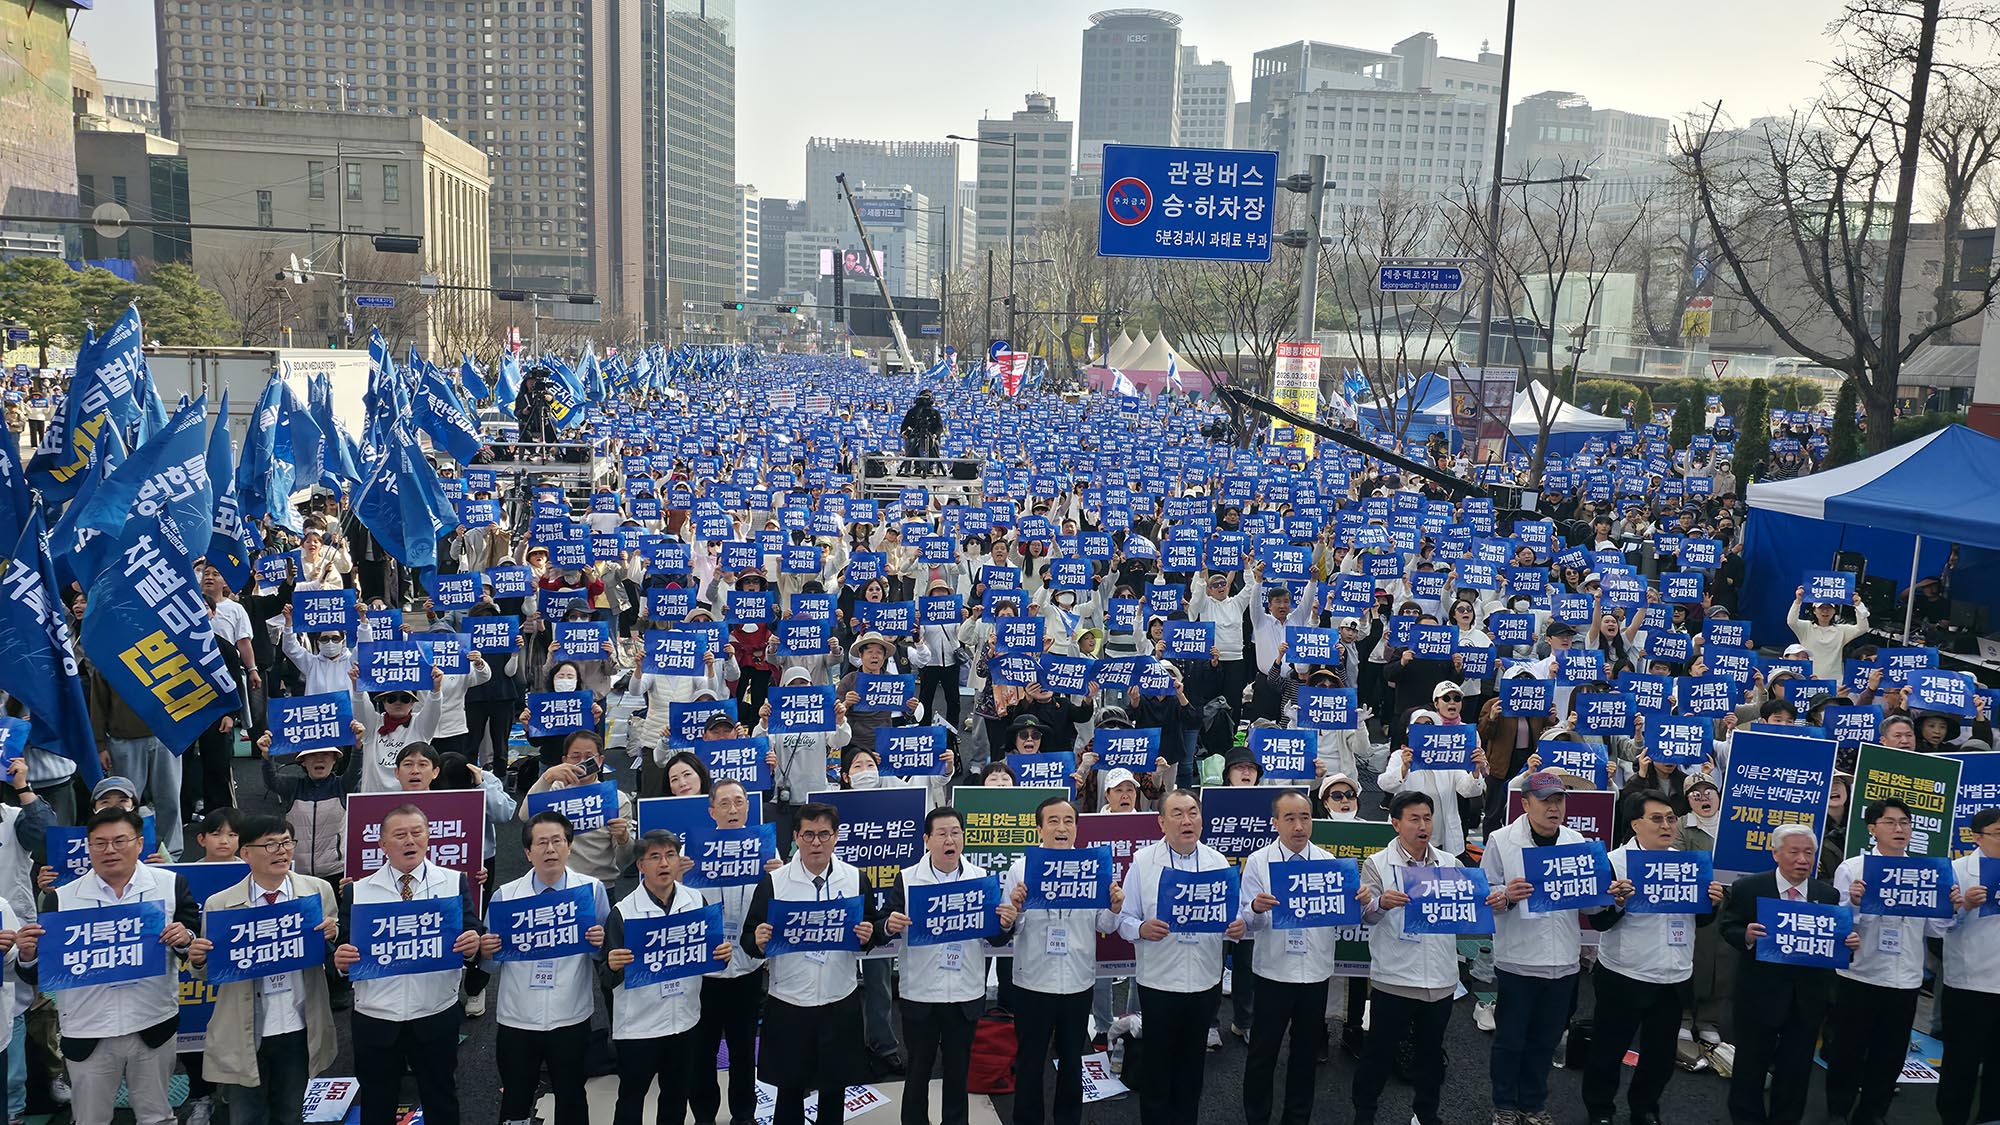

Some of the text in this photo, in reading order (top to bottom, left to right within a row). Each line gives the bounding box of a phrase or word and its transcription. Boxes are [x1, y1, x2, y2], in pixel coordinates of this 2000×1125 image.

[1127, 34, 1148, 43] ICBC
[1167, 160, 1264, 188] 관광버스
[1114, 197, 1146, 206] 주차금지
[1162, 193, 1265, 221] 승·하차장
[1155, 229, 1267, 249] 5분경과시 과태료 부과
[1383, 269, 1440, 281] 세종대로21길
[557, 544, 585, 555] 거룩한
[557, 554, 586, 565] 방파제
[1059, 564, 1085, 574] 거룩한
[1058, 575, 1085, 585] 방파제
[1813, 577, 1845, 588] 거룩한
[1812, 588, 1845, 599] 방파제
[305, 597, 345, 610] 거룩한
[305, 611, 345, 625] 방파제
[876, 607, 908, 621] 거룩한
[875, 618, 908, 631] 방파제
[433, 640, 459, 654] 룩한
[1297, 634, 1330, 646] 거룩한
[433, 654, 459, 668] 파제
[1296, 646, 1330, 658] 방파제
[118, 630, 219, 722] 반대
[782, 694, 824, 708] 거룩한
[1589, 701, 1626, 715] 거룩한
[284, 703, 338, 723] 거룩한
[781, 710, 823, 726] 방파제
[1837, 713, 1875, 727] 거룩한
[1587, 716, 1626, 729] 방파제
[284, 722, 339, 743] 방파제
[1424, 734, 1466, 749] 거룩한
[1834, 727, 1874, 742] 방파제
[890, 736, 934, 752] 거룩한
[1108, 738, 1149, 752] 거룩한
[1263, 739, 1305, 754] 거룩한
[710, 748, 757, 766] 거룩한
[889, 753, 933, 768] 방파제
[1105, 753, 1147, 765] 방파제
[1262, 755, 1304, 771] 방파제
[1421, 750, 1465, 763] 방파제
[1552, 750, 1598, 768] 거룩한
[1021, 762, 1064, 777] 거룩한
[1736, 764, 1824, 787] 이름은 차별금지,
[1868, 769, 1946, 795] 특권 없는 평등이
[1731, 783, 1821, 804] 실체는 반대금지!
[547, 795, 603, 817] 거룩한
[1730, 805, 1763, 824] 가짜
[573, 814, 603, 830] 파제
[966, 813, 991, 827] 특권
[992, 813, 1016, 827] 없는
[1211, 816, 1238, 833] 입을
[1239, 816, 1268, 833] 막는
[1567, 816, 1599, 832] 권리,
[853, 822, 884, 840] 막는
[886, 820, 916, 838] 법은
[966, 829, 996, 844] 진짜
[703, 838, 761, 858] 거룩한
[874, 843, 914, 860] 아니라
[702, 859, 760, 878] 방파제
[1043, 860, 1099, 879] 거룩한
[1543, 855, 1594, 876] 거룩한
[1645, 863, 1699, 882] 거룩한
[1289, 871, 1344, 893] 거룩한
[1882, 868, 1939, 887] 거룩한
[1041, 881, 1097, 900] 방파제
[1174, 881, 1227, 903] 거룩한
[1422, 879, 1474, 900] 거룩한
[1544, 877, 1597, 900] 방파제
[1644, 884, 1697, 903] 방파제
[928, 890, 985, 913] 거룩한
[1289, 895, 1344, 917] 방파제
[1880, 888, 1937, 908] 방파제
[512, 901, 577, 928] 거룩한
[786, 909, 847, 926] 거룩한
[1173, 903, 1226, 923] 방파제
[1422, 903, 1476, 923] 방파제
[65, 918, 144, 945] 거룩한
[231, 913, 304, 942] 거룩한
[372, 912, 443, 937] 거룩한
[927, 911, 984, 935] 방파제
[1777, 913, 1836, 936] 거룩한
[512, 924, 578, 951] 방파제
[645, 920, 708, 947] 거룩한
[784, 927, 844, 943] 방파제
[230, 937, 304, 969] 방파제
[371, 937, 442, 965] 방파제
[1776, 934, 1834, 957] 방파제
[64, 943, 143, 975] 방파제
[644, 943, 706, 972] 방파제
[269, 974, 286, 982] VIP
